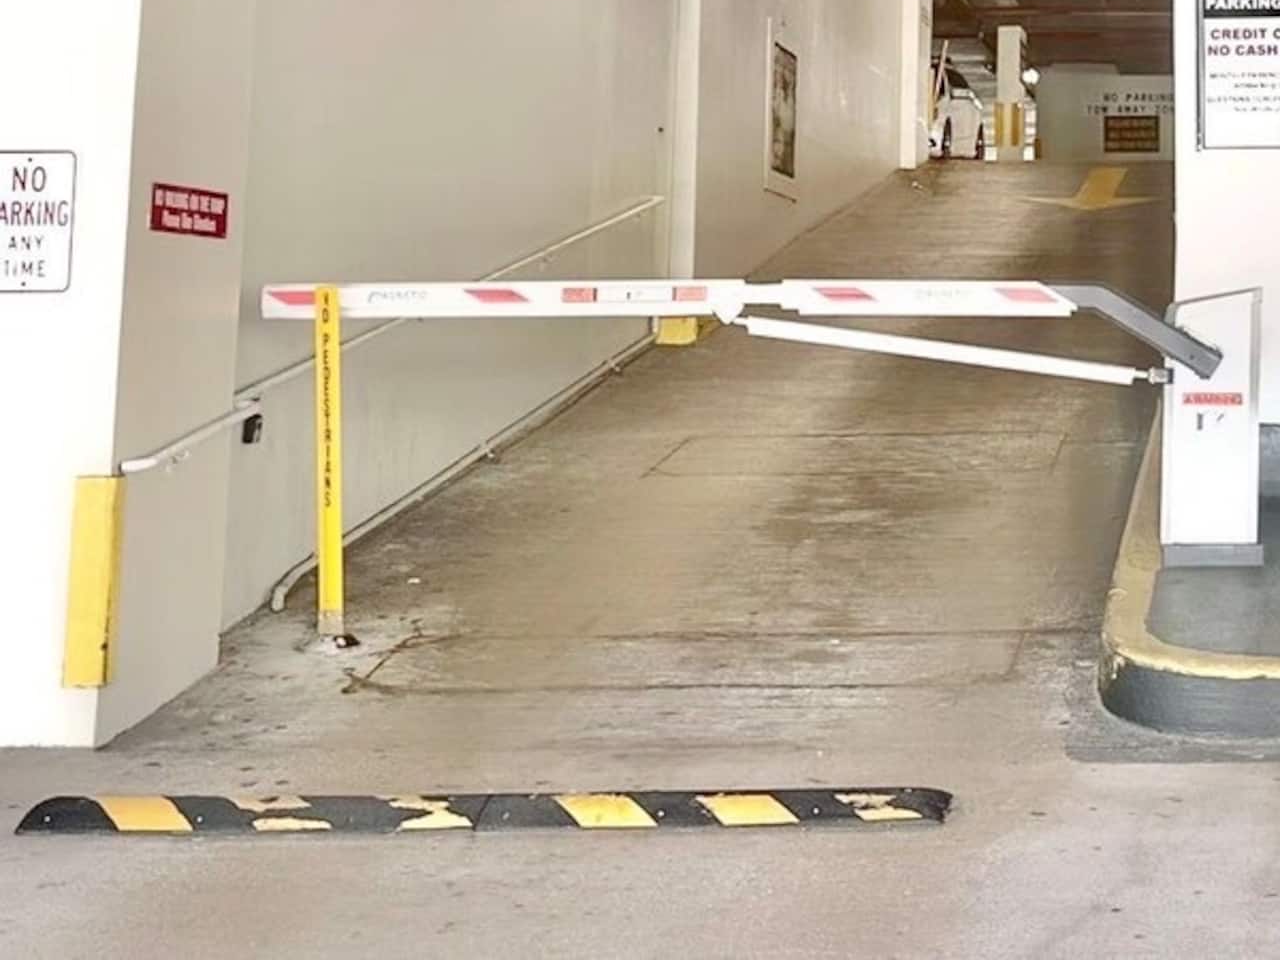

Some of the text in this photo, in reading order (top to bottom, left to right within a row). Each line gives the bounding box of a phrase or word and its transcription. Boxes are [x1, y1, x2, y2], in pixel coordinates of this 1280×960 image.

[1210, 27, 1267, 40] CREDIT
[1207, 44, 1230, 56] NO
[1235, 44, 1279, 56] CASH
[12, 166, 47, 193] NO
[8, 235, 45, 251] ANY
[4, 259, 47, 278] TIME
